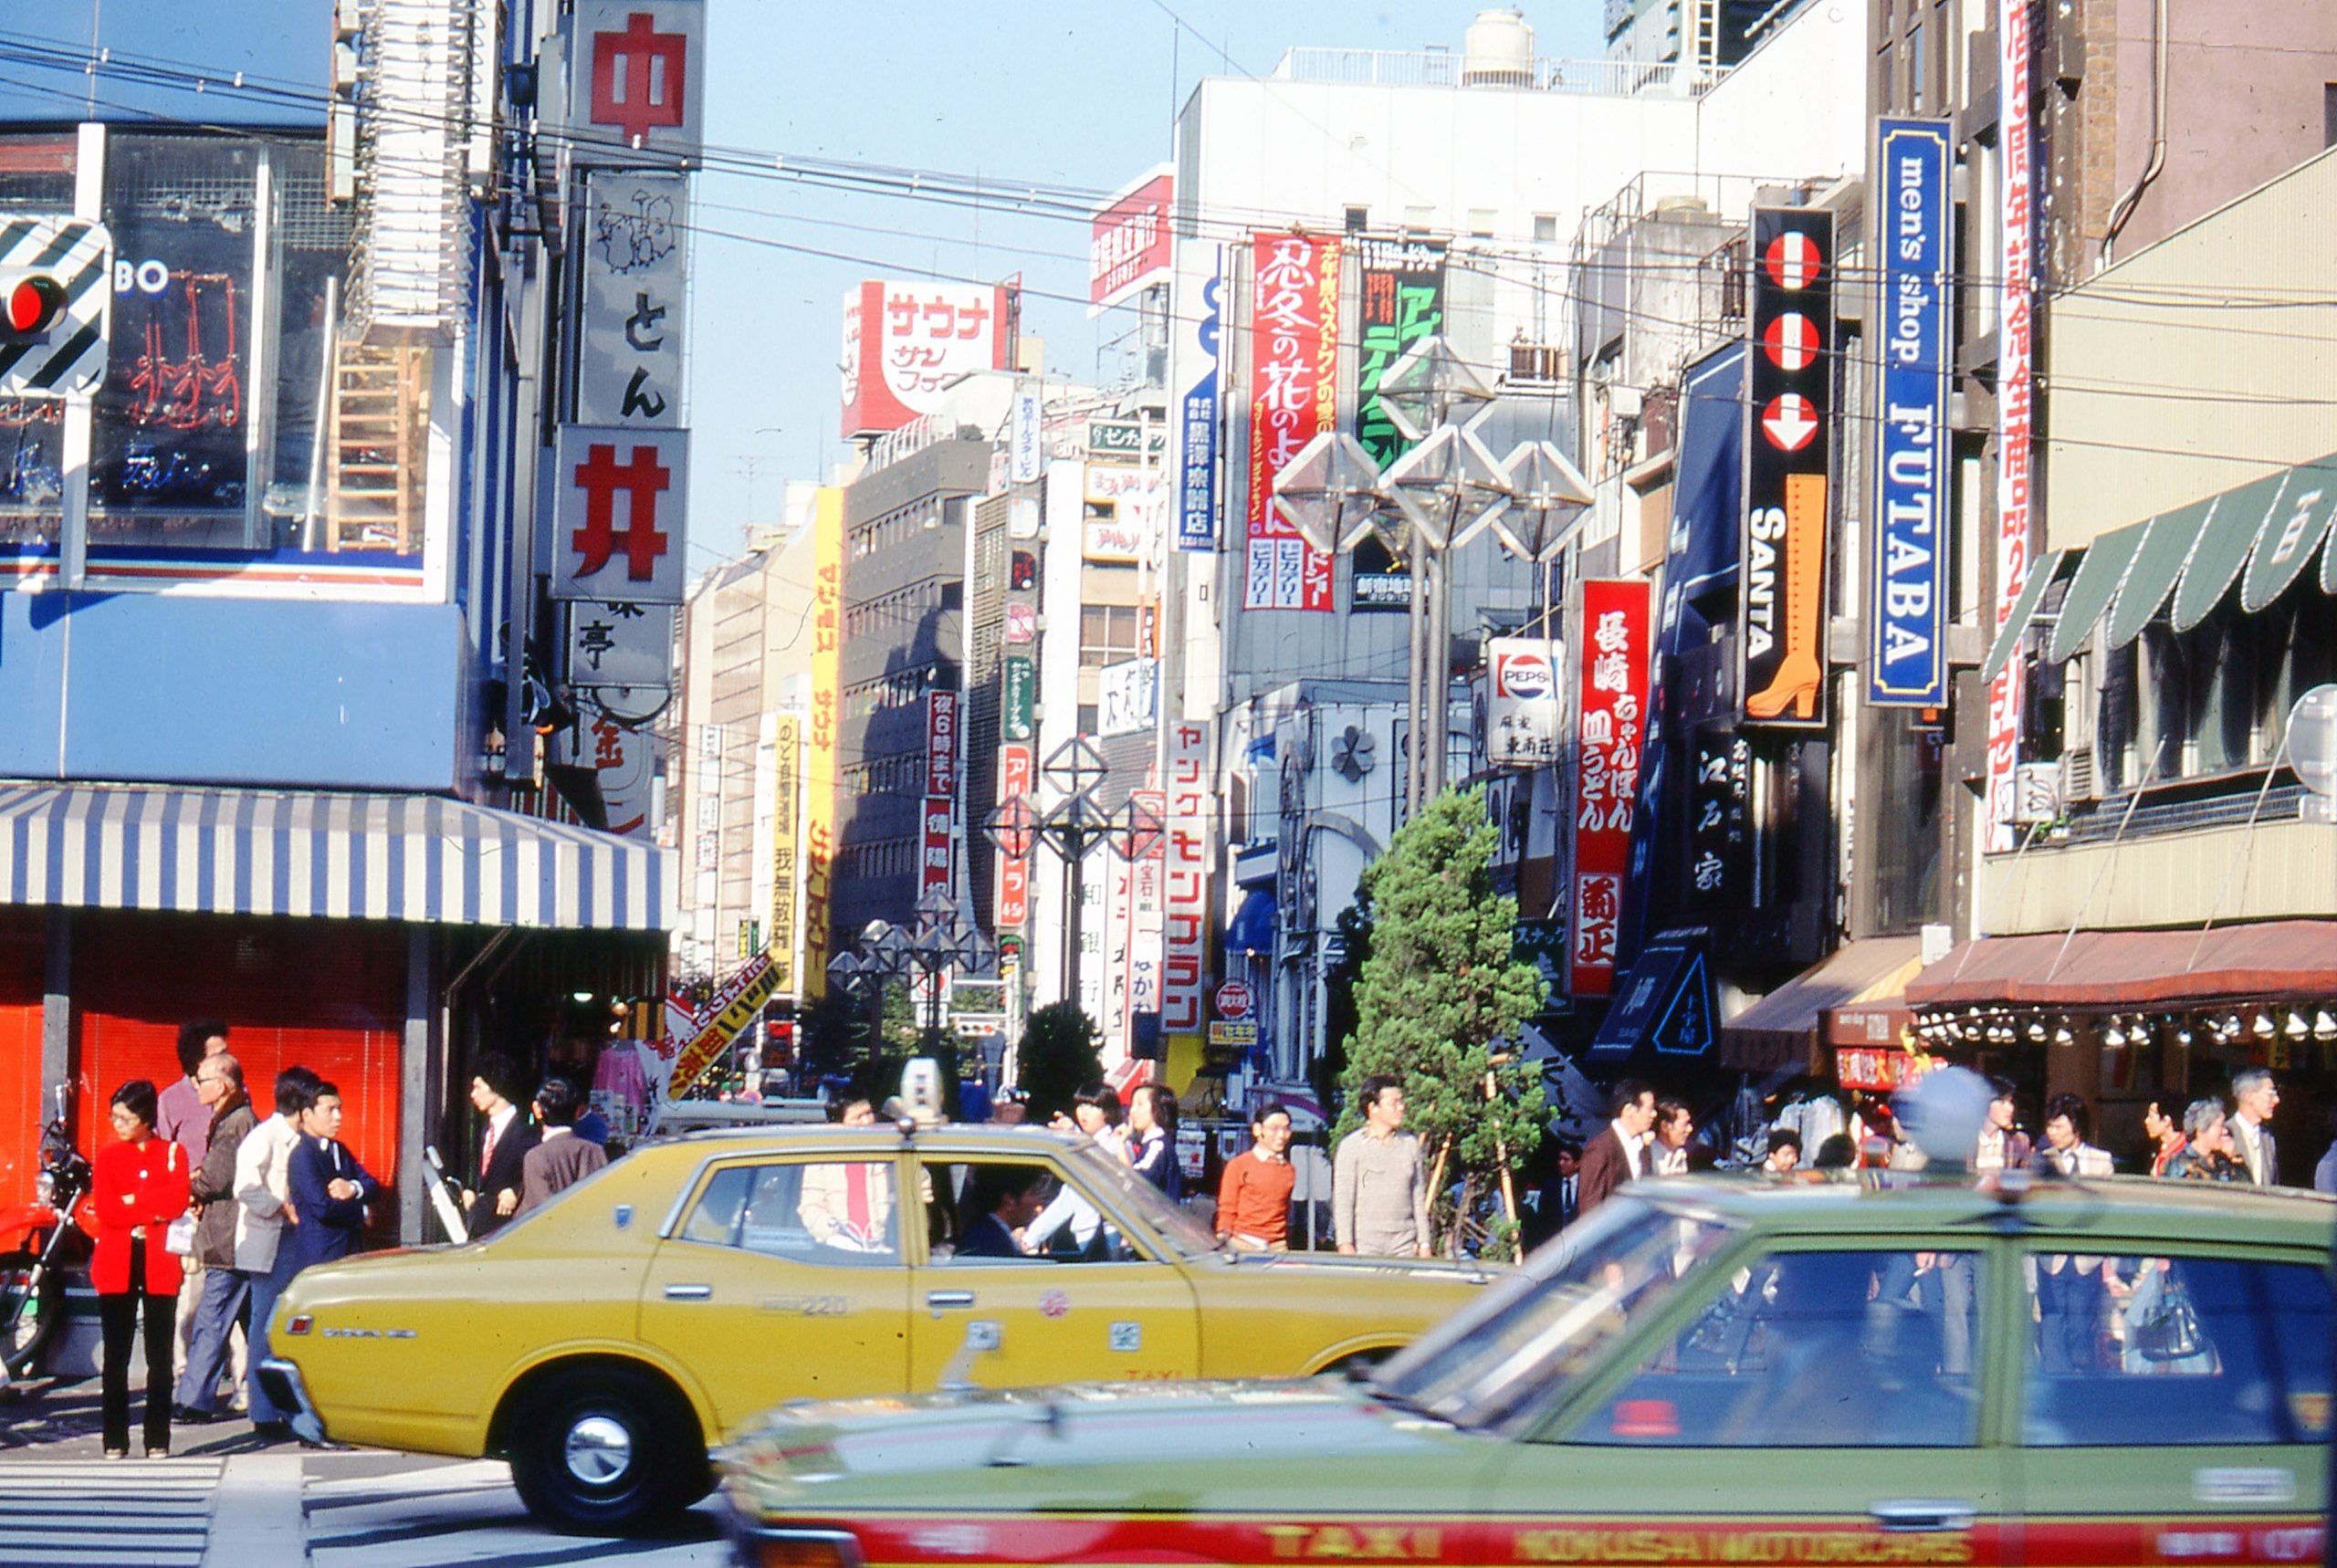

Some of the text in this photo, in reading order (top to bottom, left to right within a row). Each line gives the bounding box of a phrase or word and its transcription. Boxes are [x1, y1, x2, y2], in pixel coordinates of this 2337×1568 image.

[887, 294, 989, 340] サウナ
[1891, 157, 1923, 363] men's shop
[1748, 507, 1787, 661] SANTA
[1885, 402, 1934, 665] FUTABA
[1593, 612, 1629, 692] 長崎
[932, 695, 952, 791] 夜6時まで
[1578, 709, 1614, 832] 皿うどん
[1609, 695, 1638, 832] ちゃんぽん
[1261, 1524, 1441, 1558] TAXI
